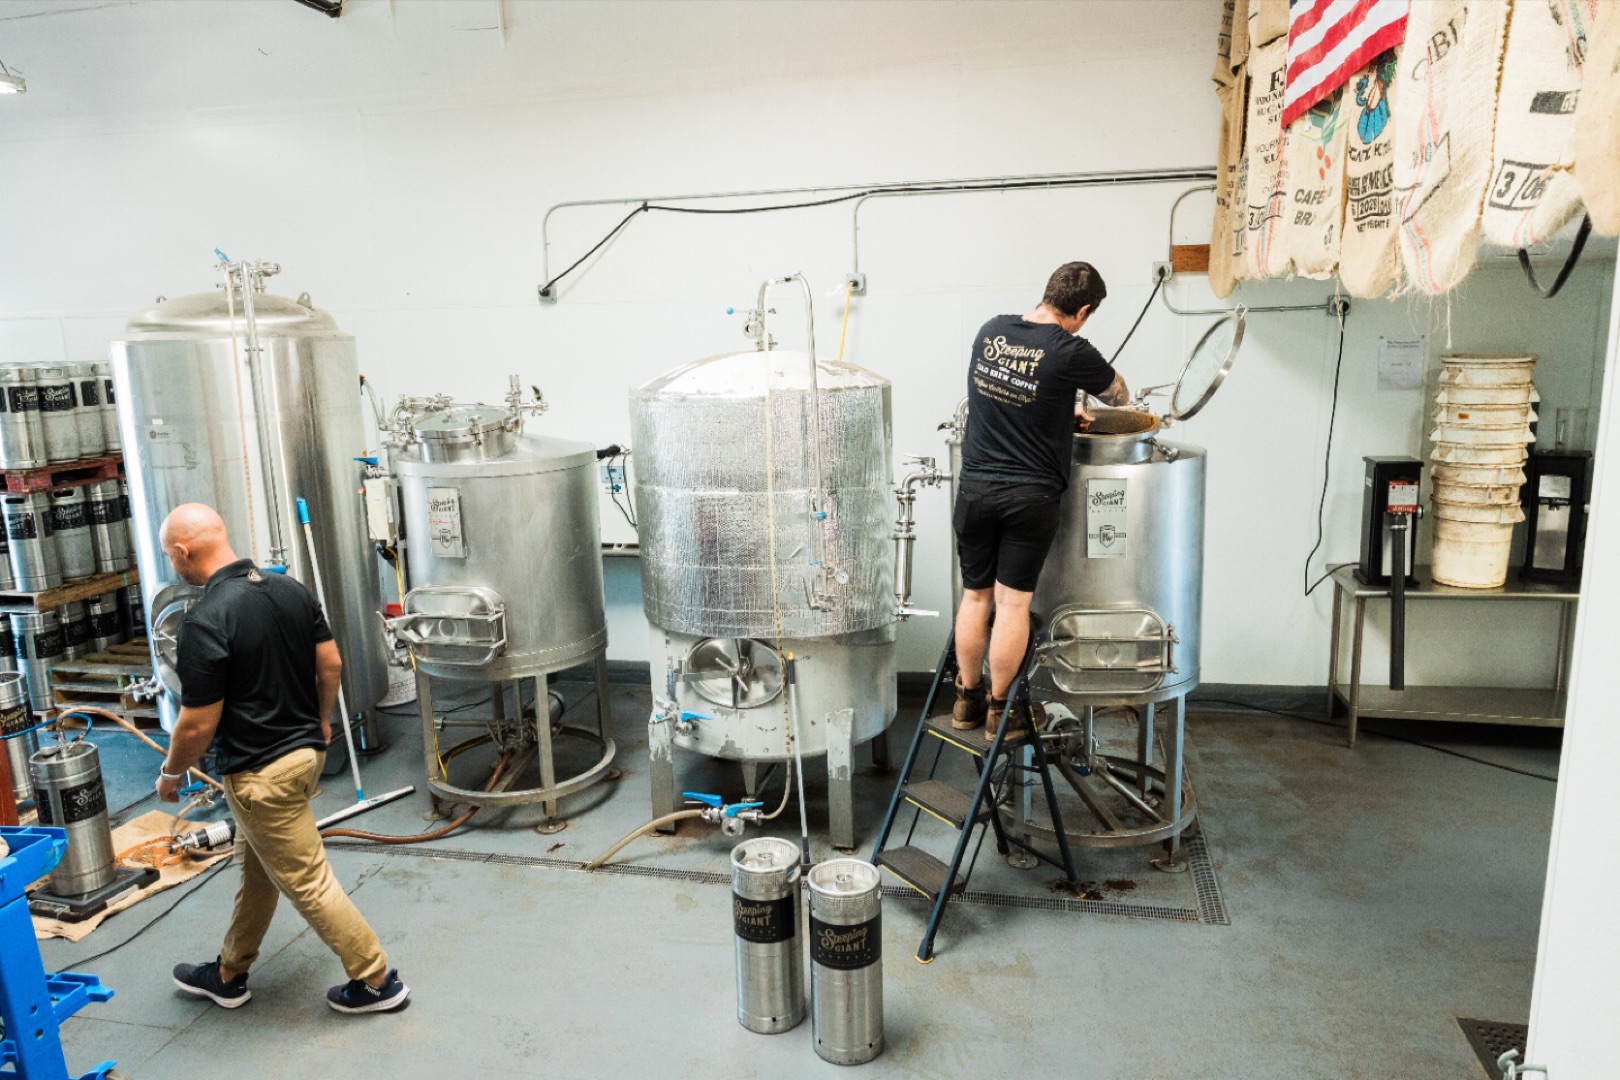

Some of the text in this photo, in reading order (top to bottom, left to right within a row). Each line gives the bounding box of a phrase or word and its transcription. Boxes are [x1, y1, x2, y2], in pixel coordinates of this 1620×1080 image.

[997, 357, 1039, 377] GIANT
[989, 368, 1010, 382] BREW
[1010, 377, 1038, 392] COFFEE
[835, 937, 866, 953] GIANT
